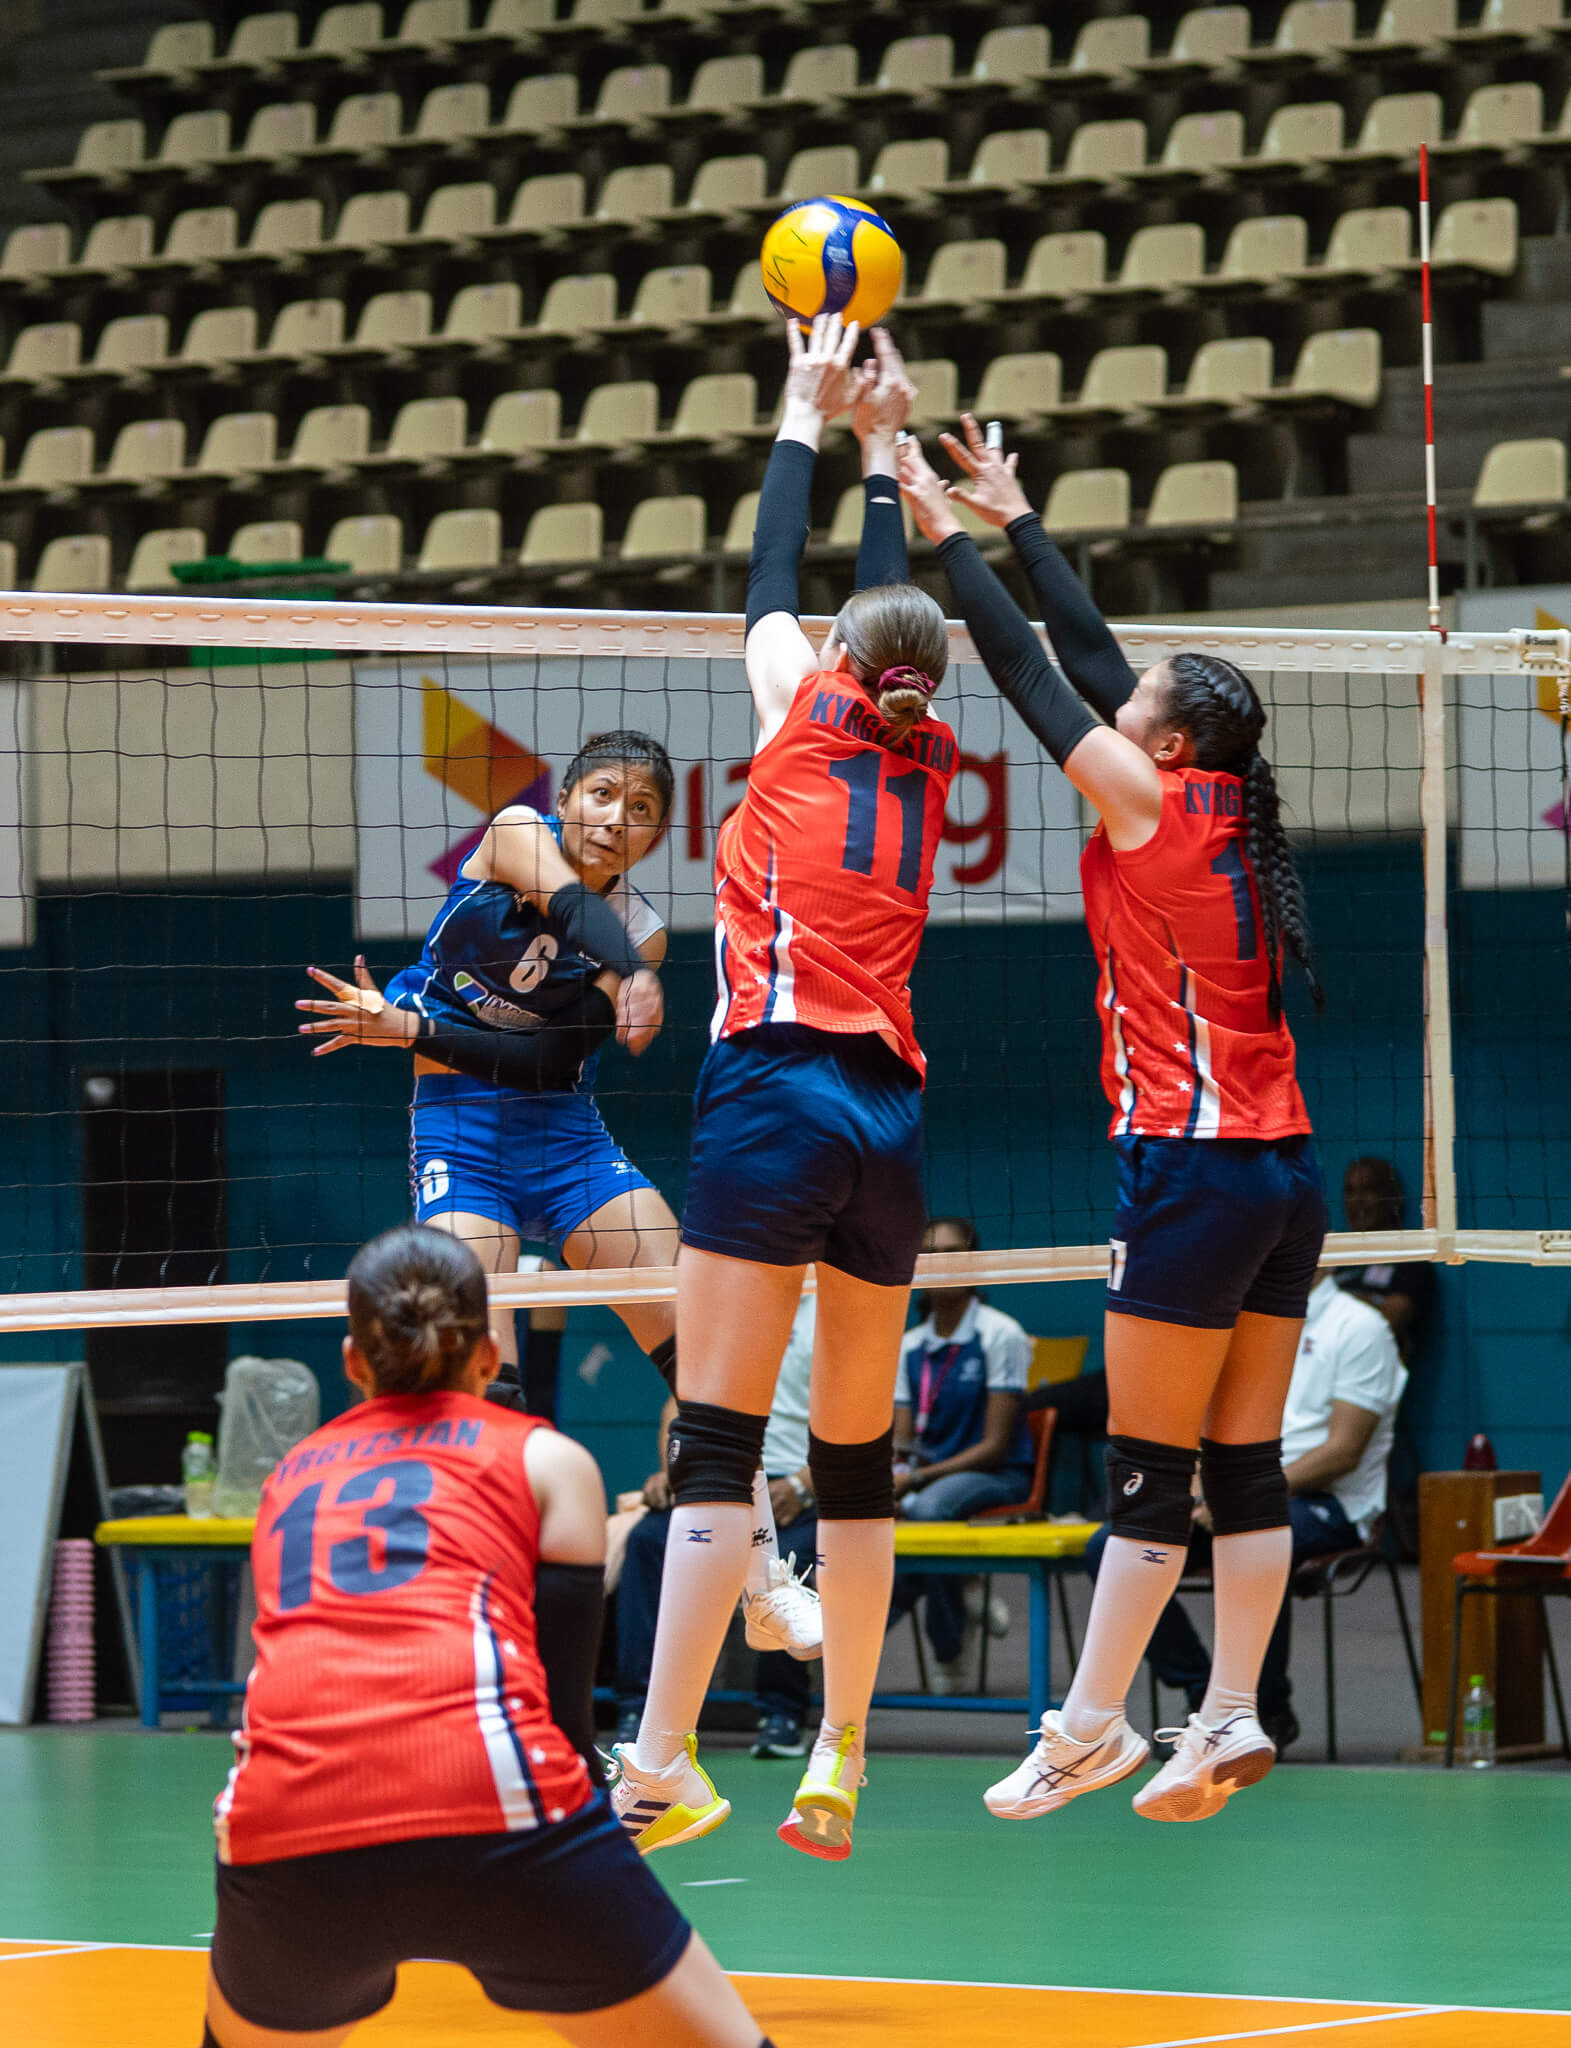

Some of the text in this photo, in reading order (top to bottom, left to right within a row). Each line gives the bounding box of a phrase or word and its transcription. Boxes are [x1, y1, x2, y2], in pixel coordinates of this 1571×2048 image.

[829, 749, 928, 894] 11
[509, 933, 559, 994] 6
[276, 1420, 484, 1485] YRGYZSTAN
[270, 1459, 434, 1611] 13
